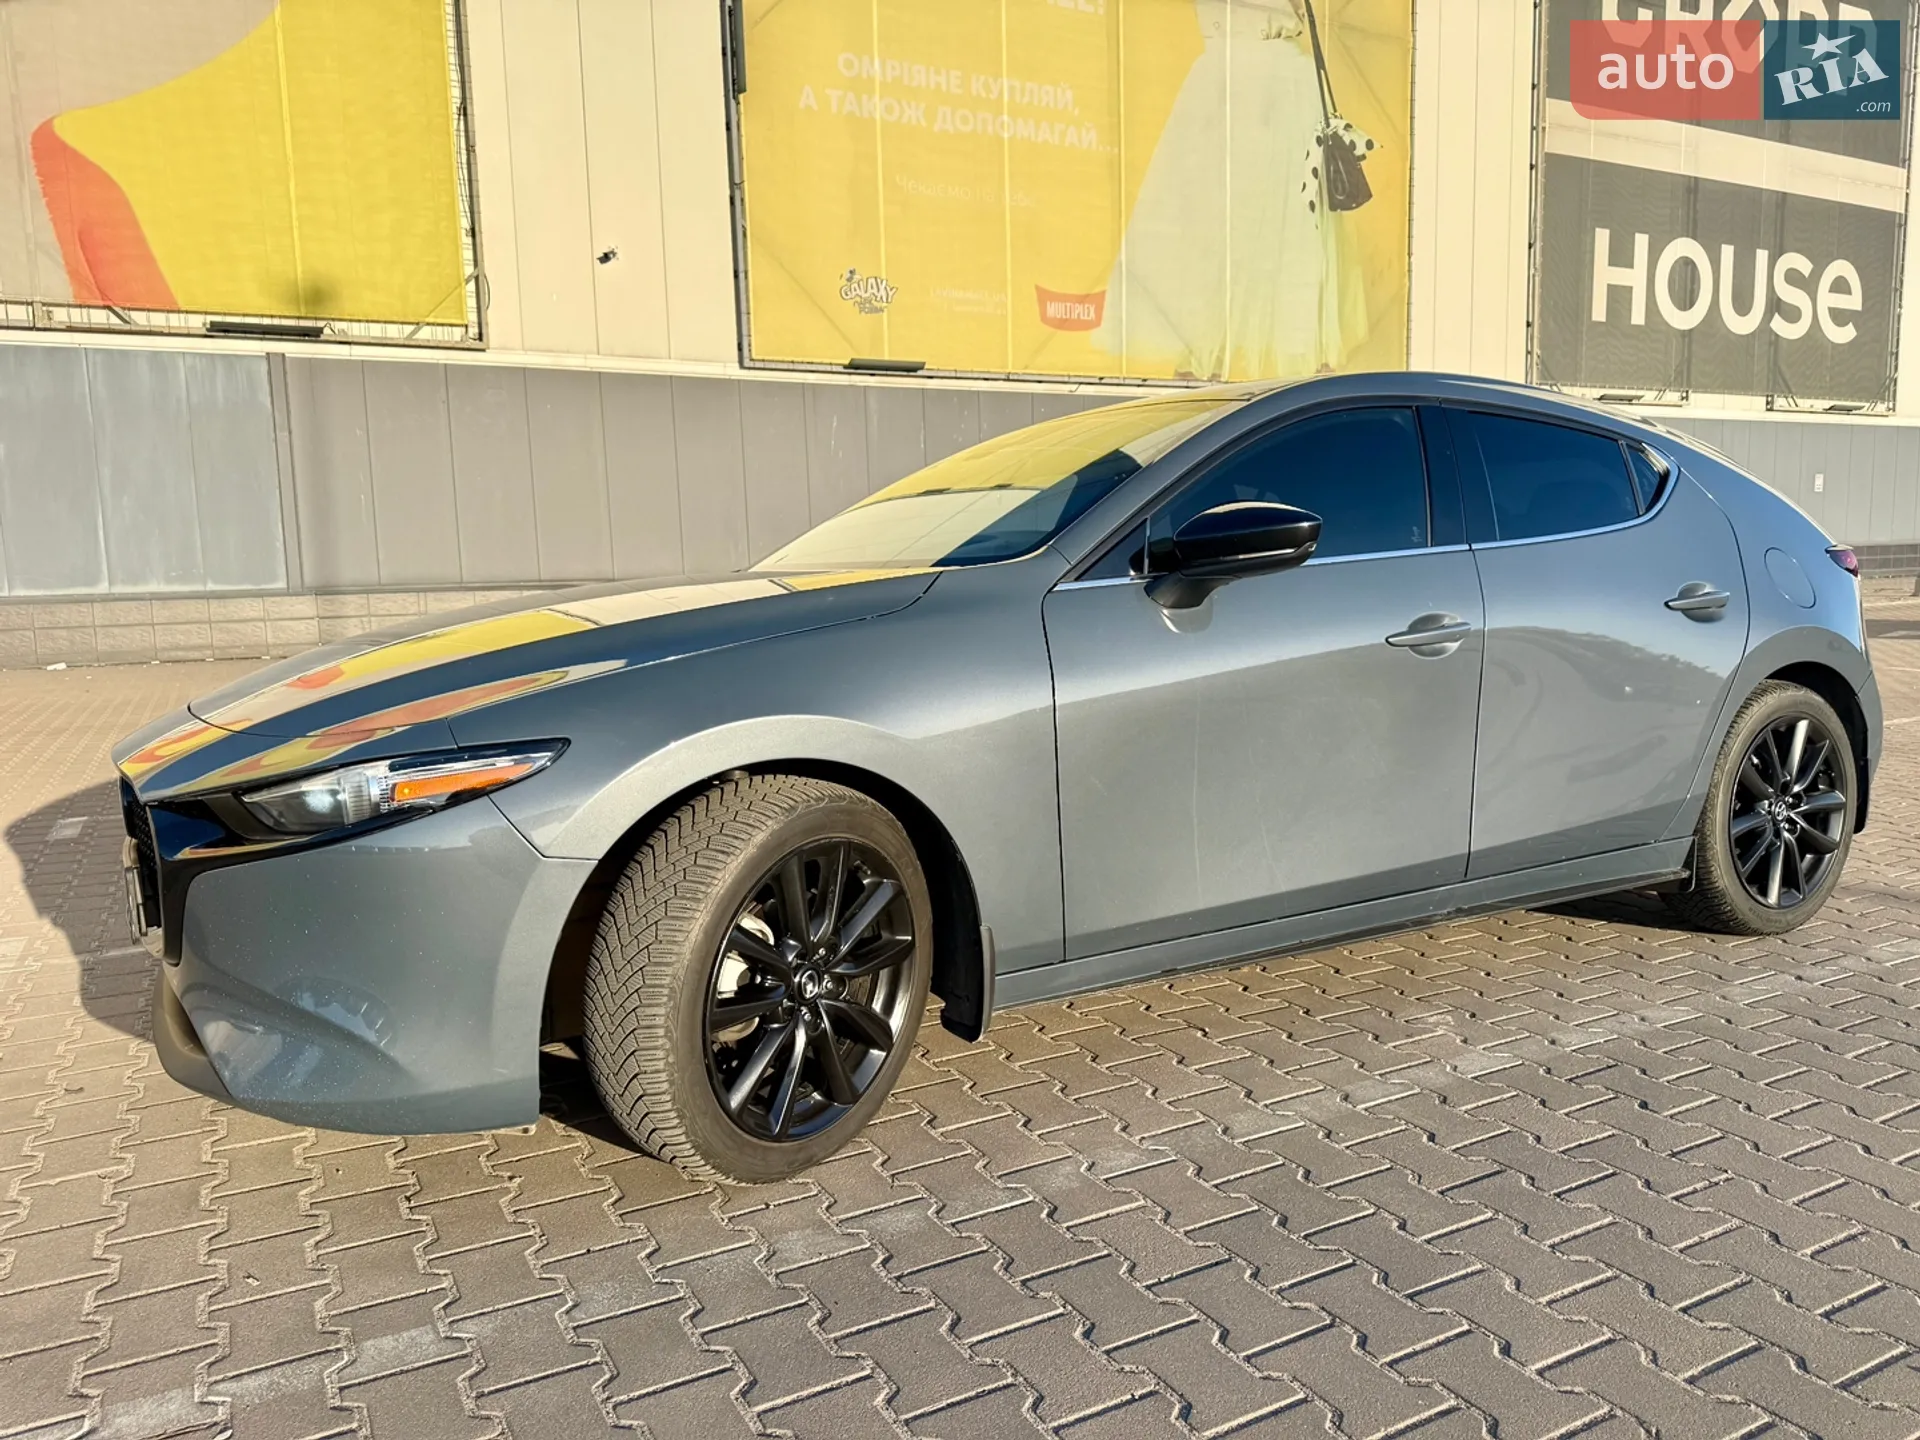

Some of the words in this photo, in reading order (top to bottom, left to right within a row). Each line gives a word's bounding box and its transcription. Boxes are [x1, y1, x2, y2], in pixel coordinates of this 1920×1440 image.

[837, 52, 964, 94] ОМРІЯНЕ
[970, 73, 1080, 117] КУПЛЯЙ,
[799, 85, 818, 112] А
[825, 88, 928, 127] ТАКОЖ
[840, 276, 898, 303] GALAXY
[1046, 300, 1096, 321] MULTIPLEX
